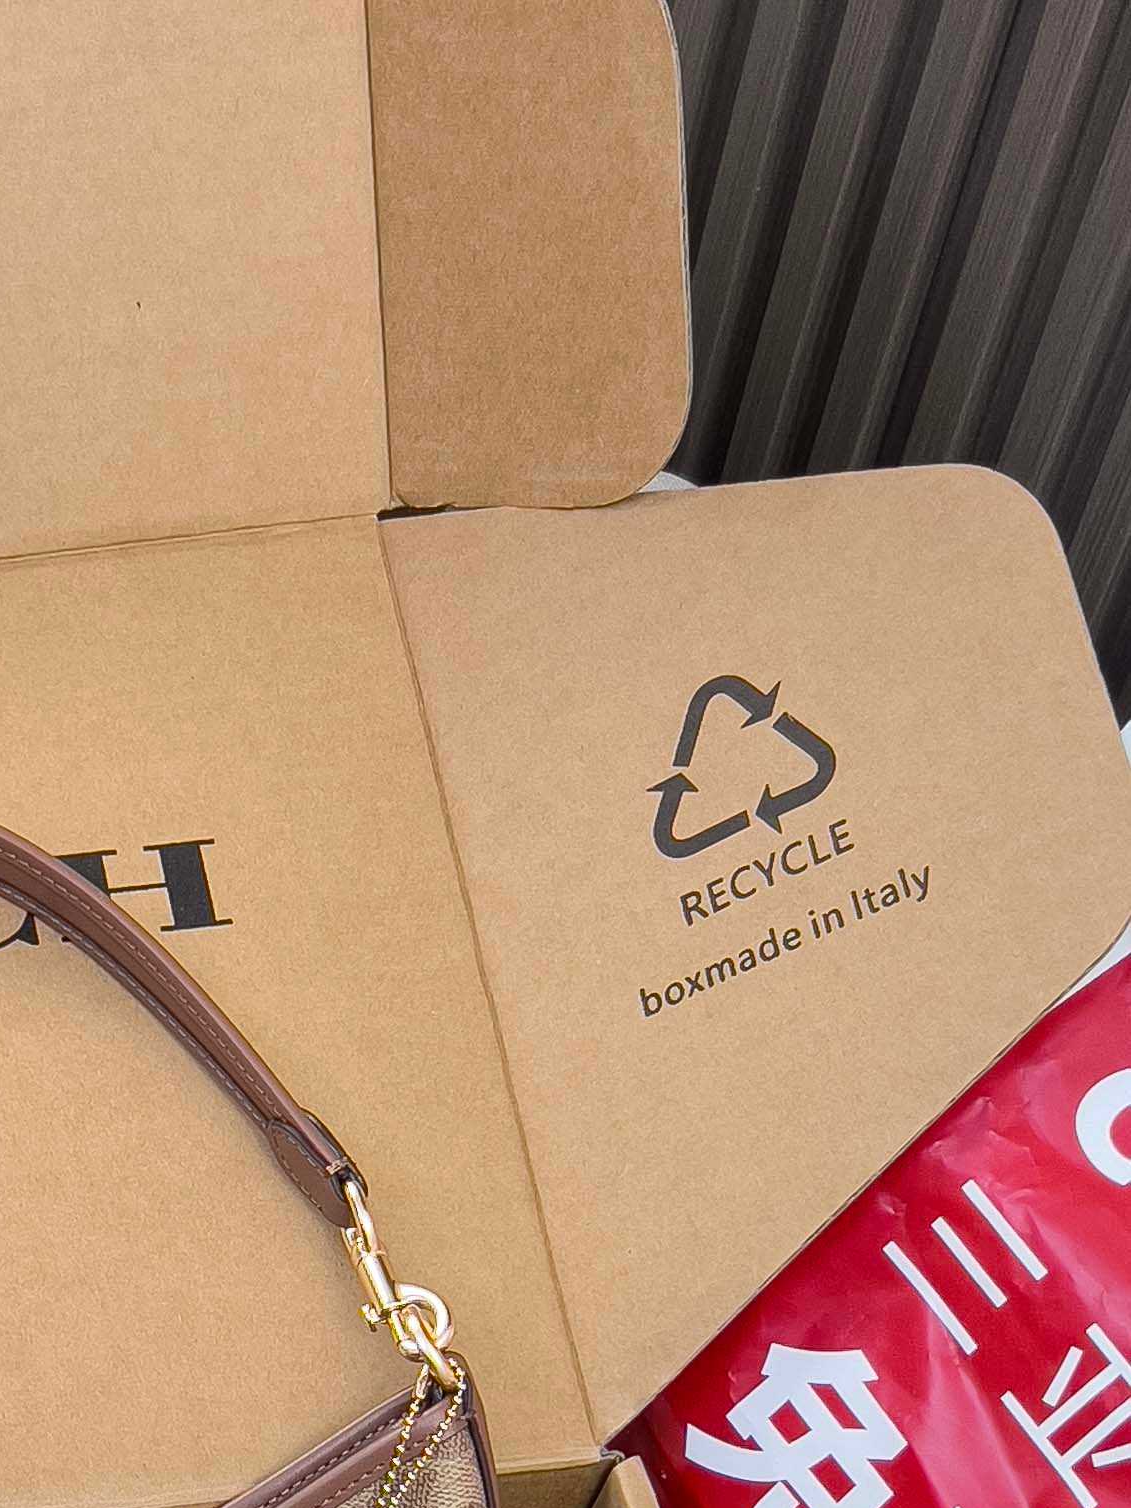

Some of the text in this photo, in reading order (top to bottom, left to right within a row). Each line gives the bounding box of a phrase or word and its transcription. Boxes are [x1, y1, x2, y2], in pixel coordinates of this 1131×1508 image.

[680, 819, 855, 926] RECYCLE
[640, 866, 930, 1017] boxmade in Italy
